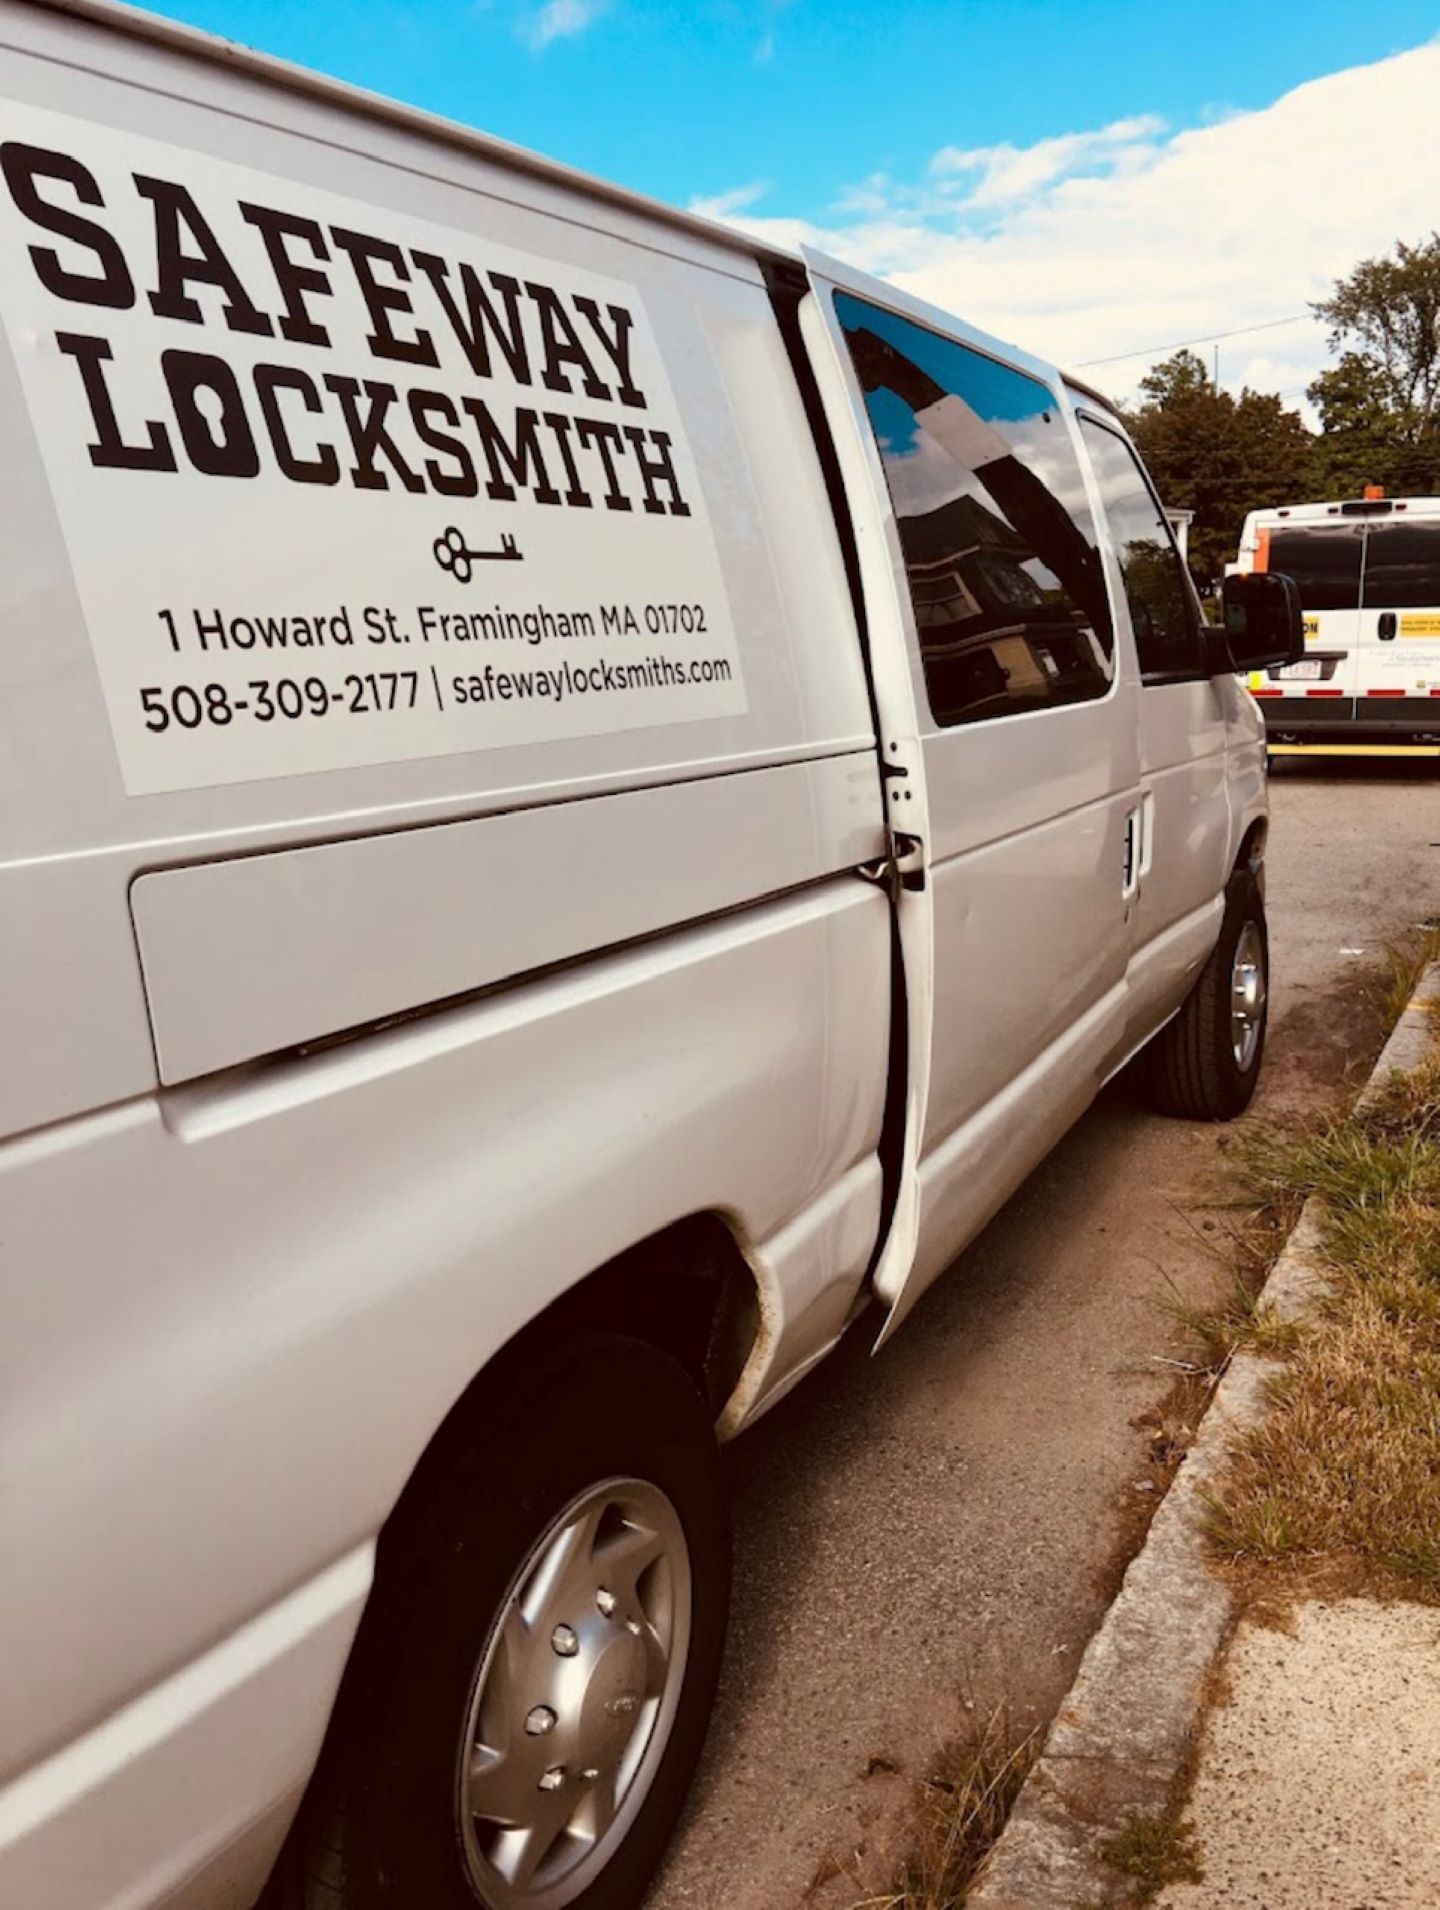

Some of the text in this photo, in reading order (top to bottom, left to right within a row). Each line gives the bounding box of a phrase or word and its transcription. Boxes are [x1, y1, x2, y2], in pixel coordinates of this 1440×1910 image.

[0, 142, 648, 410] SAFEWAY
[55, 331, 692, 517] LOCKSMITH
[158, 603, 707, 652] 1 Howard St. Framingham MA 01702
[140, 671, 418, 733] 508-309-2177
[453, 656, 731, 704] safewaylocksmiths.com
